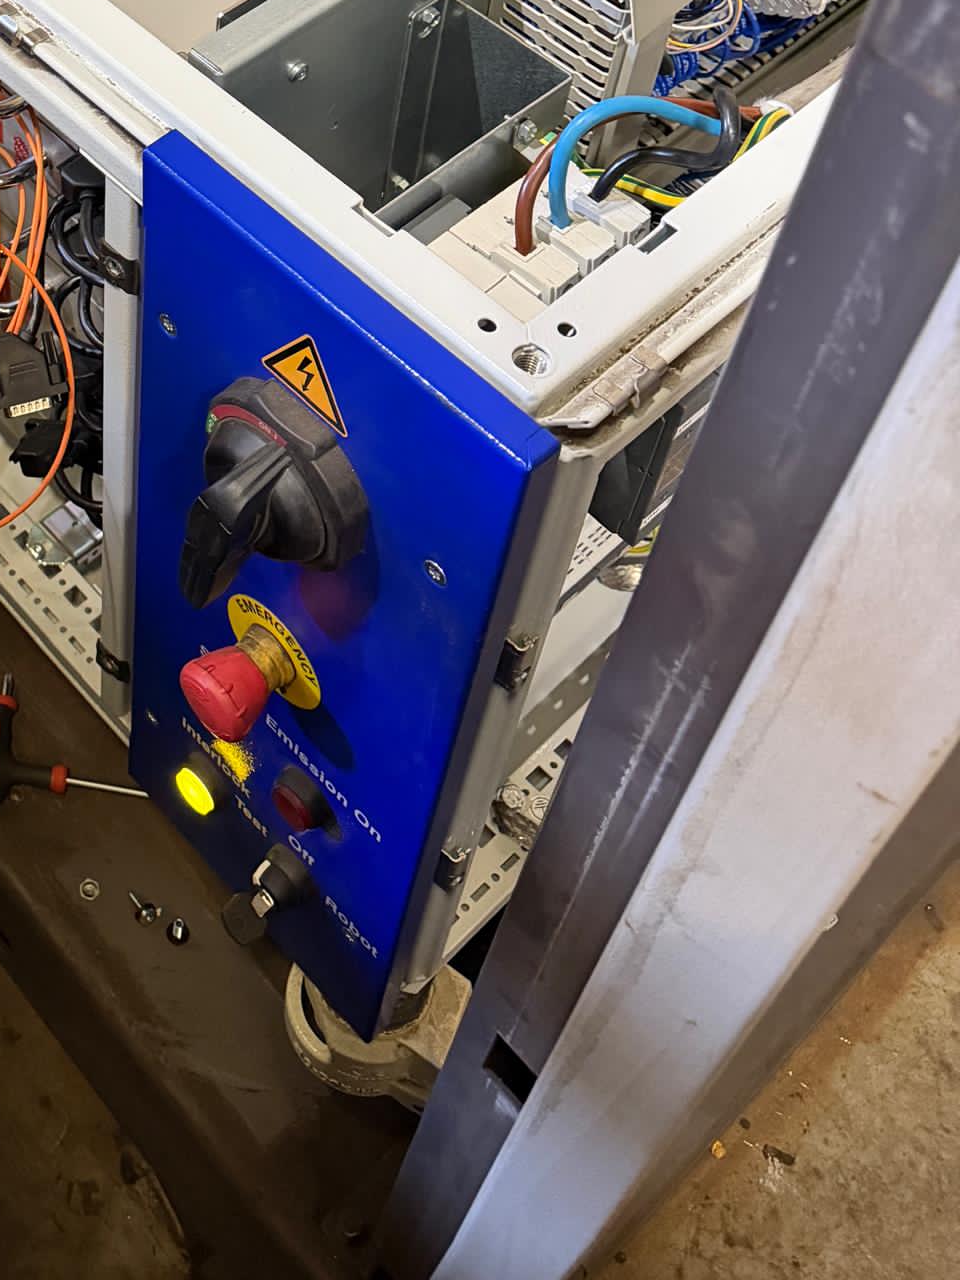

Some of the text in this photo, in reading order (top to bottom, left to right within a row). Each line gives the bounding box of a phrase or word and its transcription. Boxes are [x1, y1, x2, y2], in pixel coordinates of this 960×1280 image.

[235, 598, 318, 688] EMERGENCY
[181, 716, 252, 799] Interlock
[265, 713, 382, 844] Emission On
[234, 793, 270, 838] Test
[288, 834, 315, 866] Off
[324, 895, 379, 959] Robot
